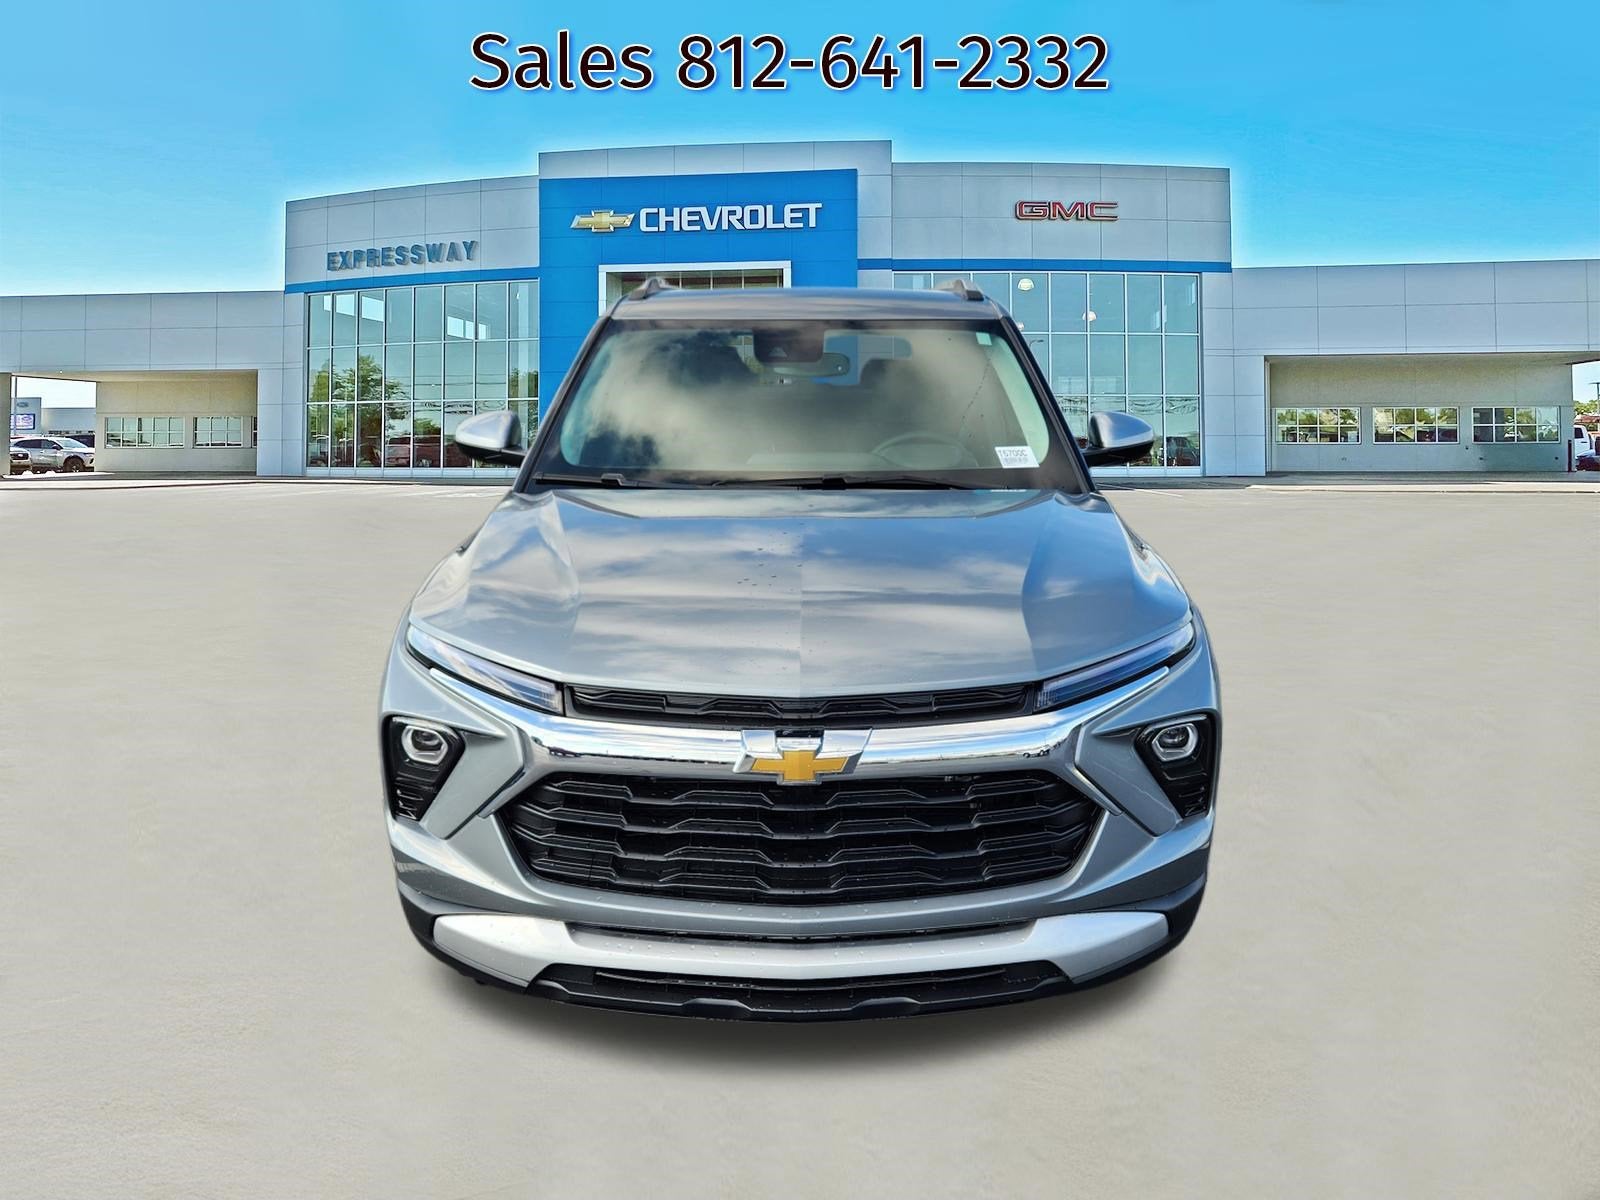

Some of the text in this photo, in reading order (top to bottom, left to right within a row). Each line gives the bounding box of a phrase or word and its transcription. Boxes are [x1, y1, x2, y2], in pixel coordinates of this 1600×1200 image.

[639, 203, 823, 232] CHEVROLET
[1015, 200, 1119, 221] GMC
[327, 240, 478, 271] EXPRESSWAY
